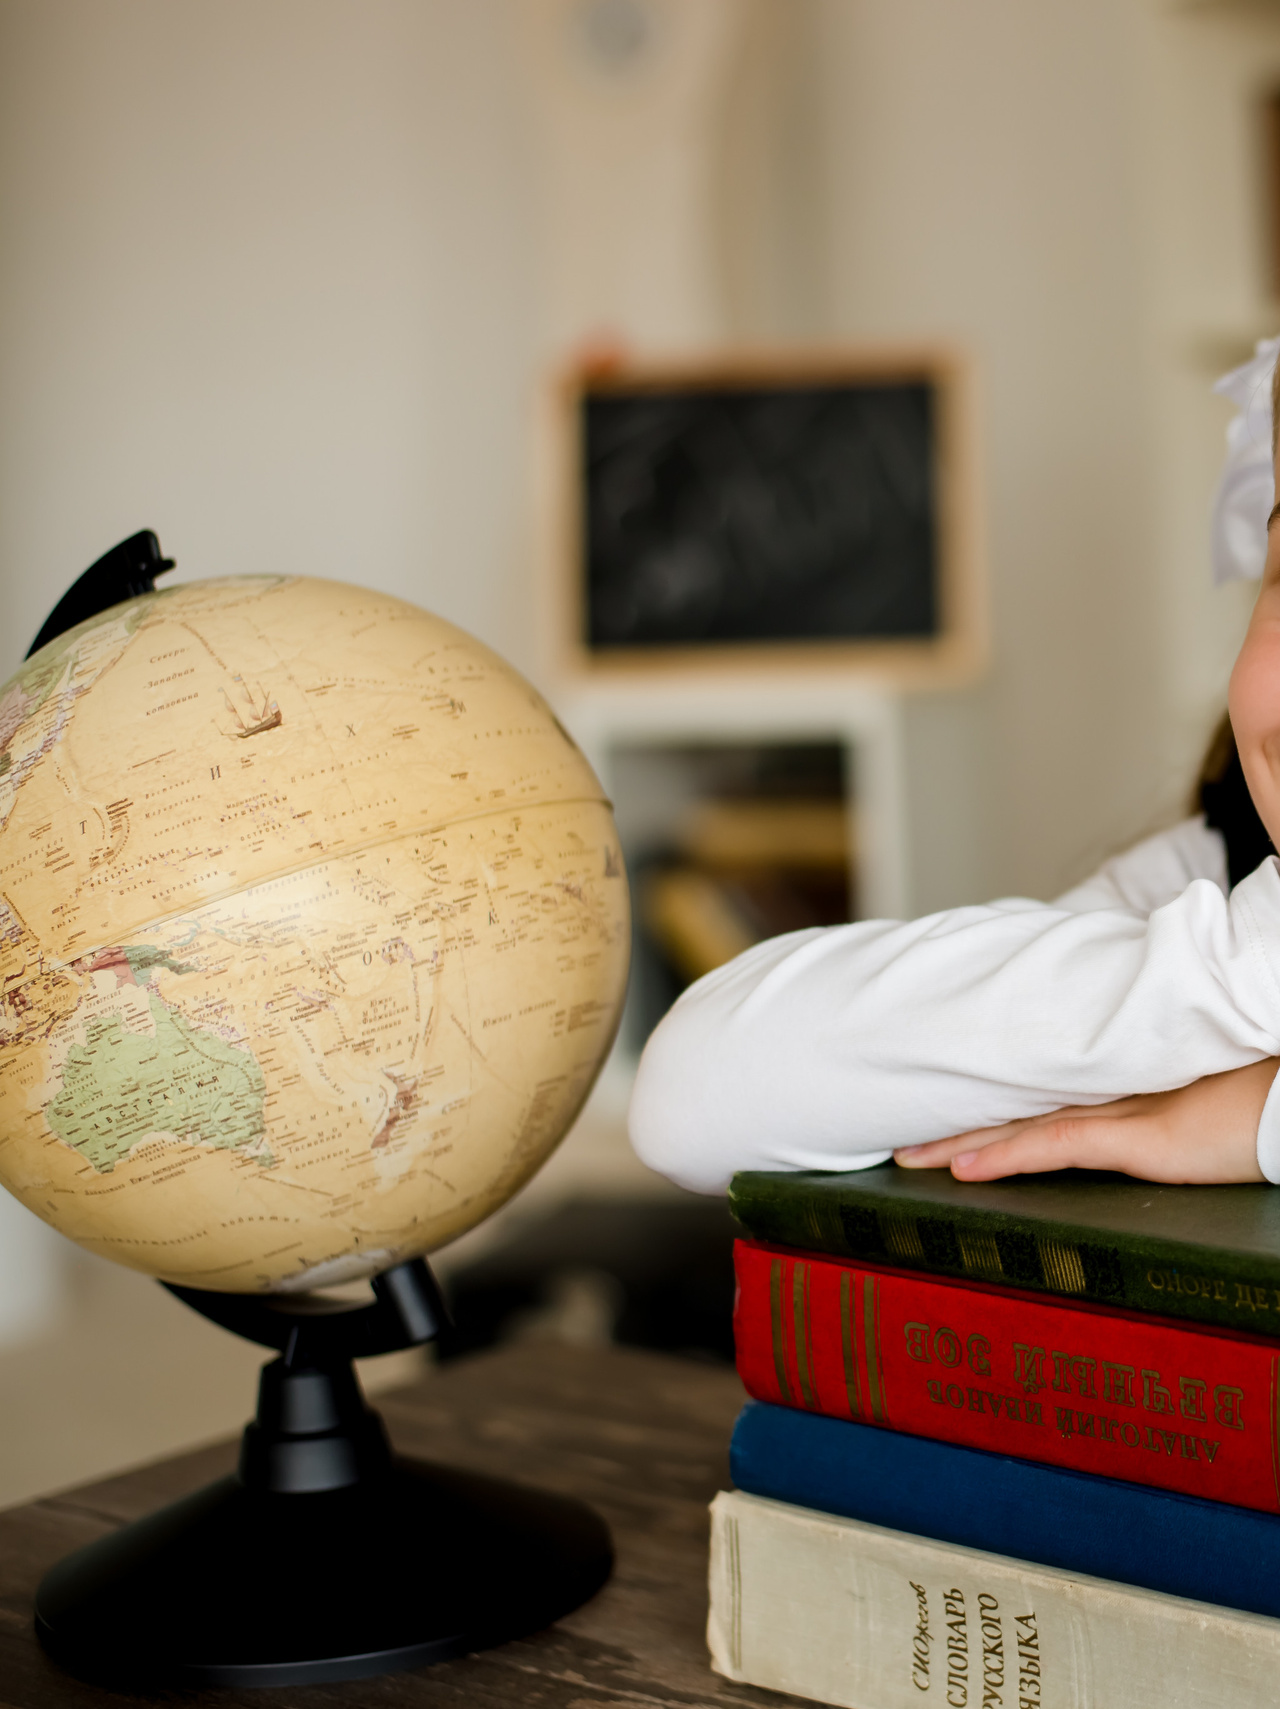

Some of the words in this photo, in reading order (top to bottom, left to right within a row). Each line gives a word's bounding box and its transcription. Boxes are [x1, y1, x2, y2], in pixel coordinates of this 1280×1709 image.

[93, 1076, 219, 1130] АВСТРАЛИЯ
[1146, 1268, 1227, 1300] ОНОРЕ
[1234, 1282, 1270, 1312] ДЕ
[903, 1320, 992, 1378] ЗОВ
[926, 1379, 1046, 1427] ИВАНОВ
[1013, 1341, 1245, 1431] ВЕЧНЫЙ
[1054, 1405, 1221, 1464] АНАТОЛИЙ
[943, 1587, 969, 1708] СЛОВАРЬ
